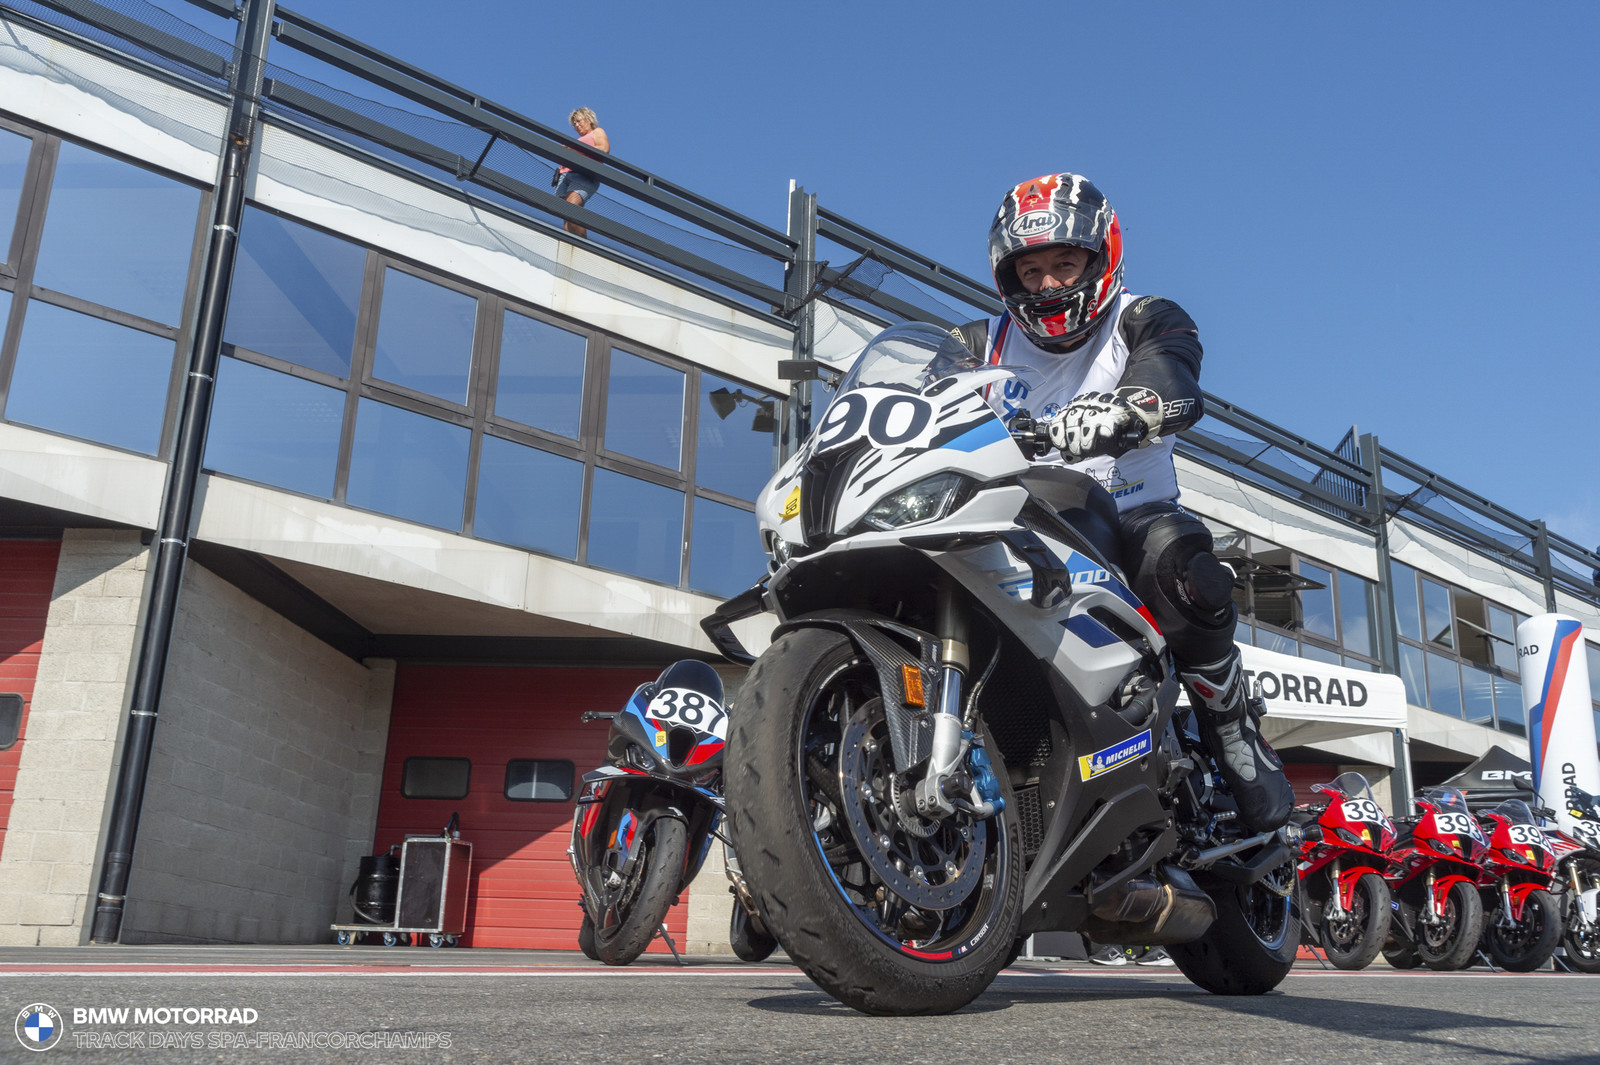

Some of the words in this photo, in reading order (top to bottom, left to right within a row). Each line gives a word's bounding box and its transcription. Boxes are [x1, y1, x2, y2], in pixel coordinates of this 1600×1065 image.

[1013, 213, 1053, 233] Arai
[651, 689, 725, 733] 387
[1105, 738, 1147, 765] MICHELIN
